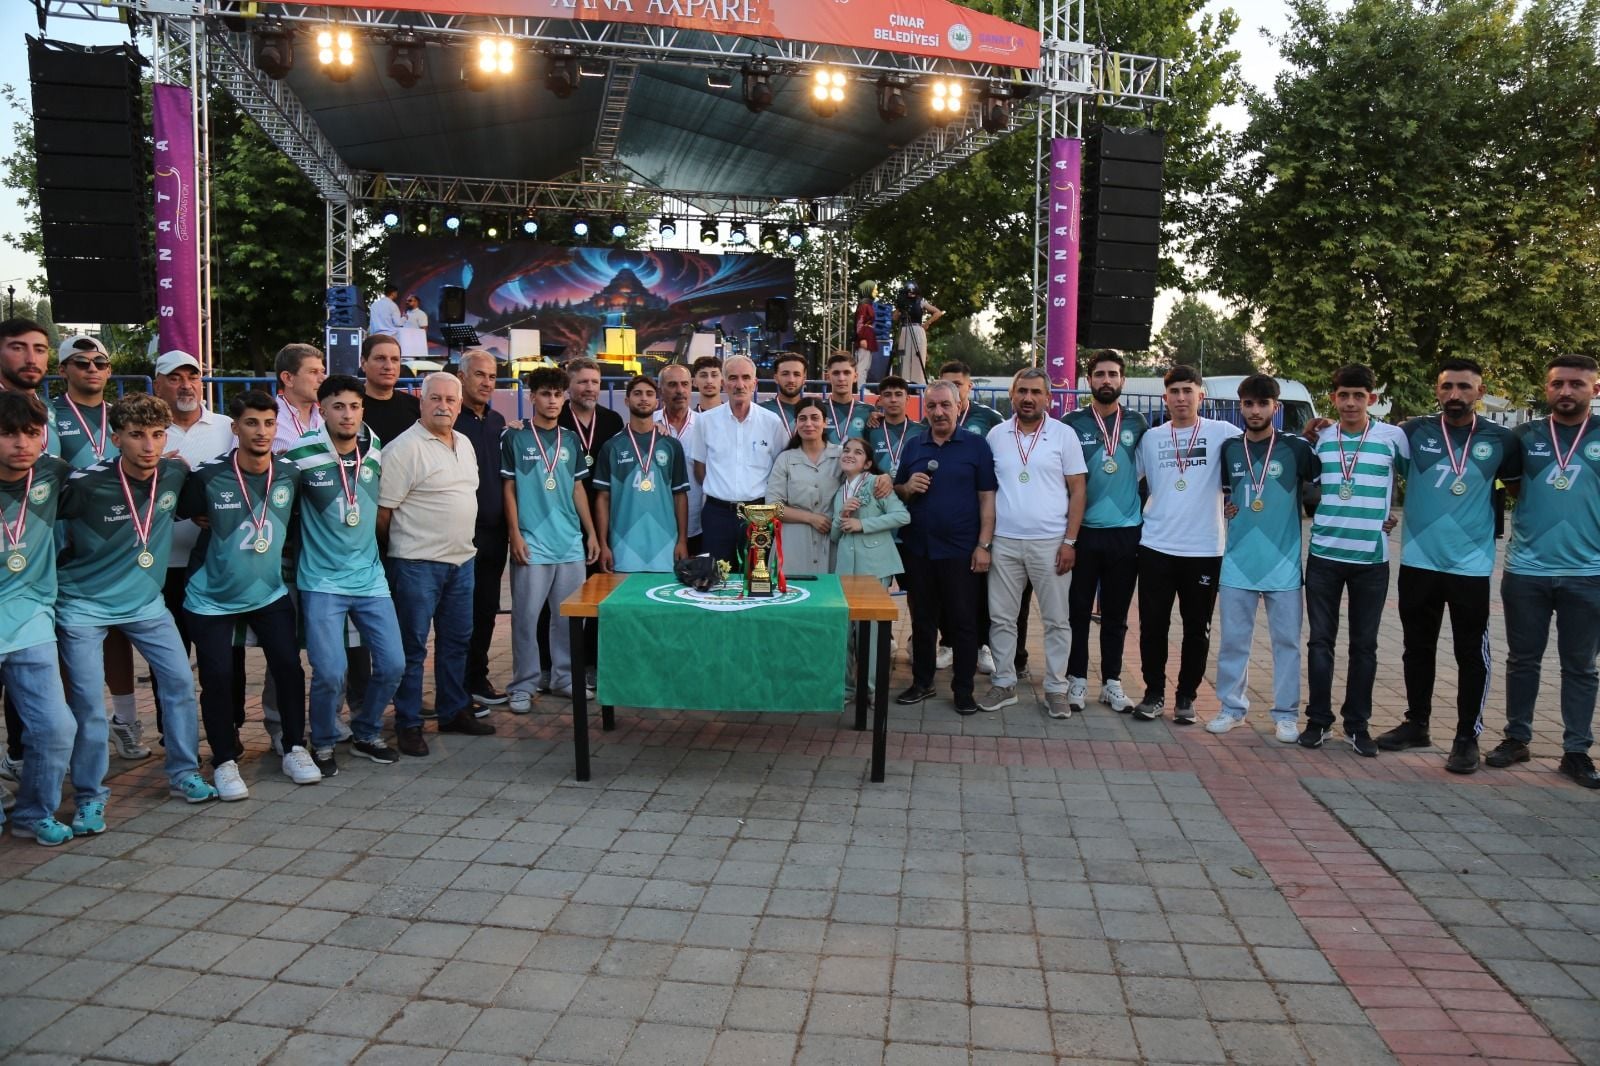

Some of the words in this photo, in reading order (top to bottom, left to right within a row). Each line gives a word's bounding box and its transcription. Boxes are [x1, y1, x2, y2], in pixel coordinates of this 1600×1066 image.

[889, 14, 925, 29] ÇINAR
[874, 28, 939, 47] BELEDİYESİ
[1545, 464, 1581, 490] 47
[214, 501, 242, 510] hummel
[239, 519, 273, 550] 20
